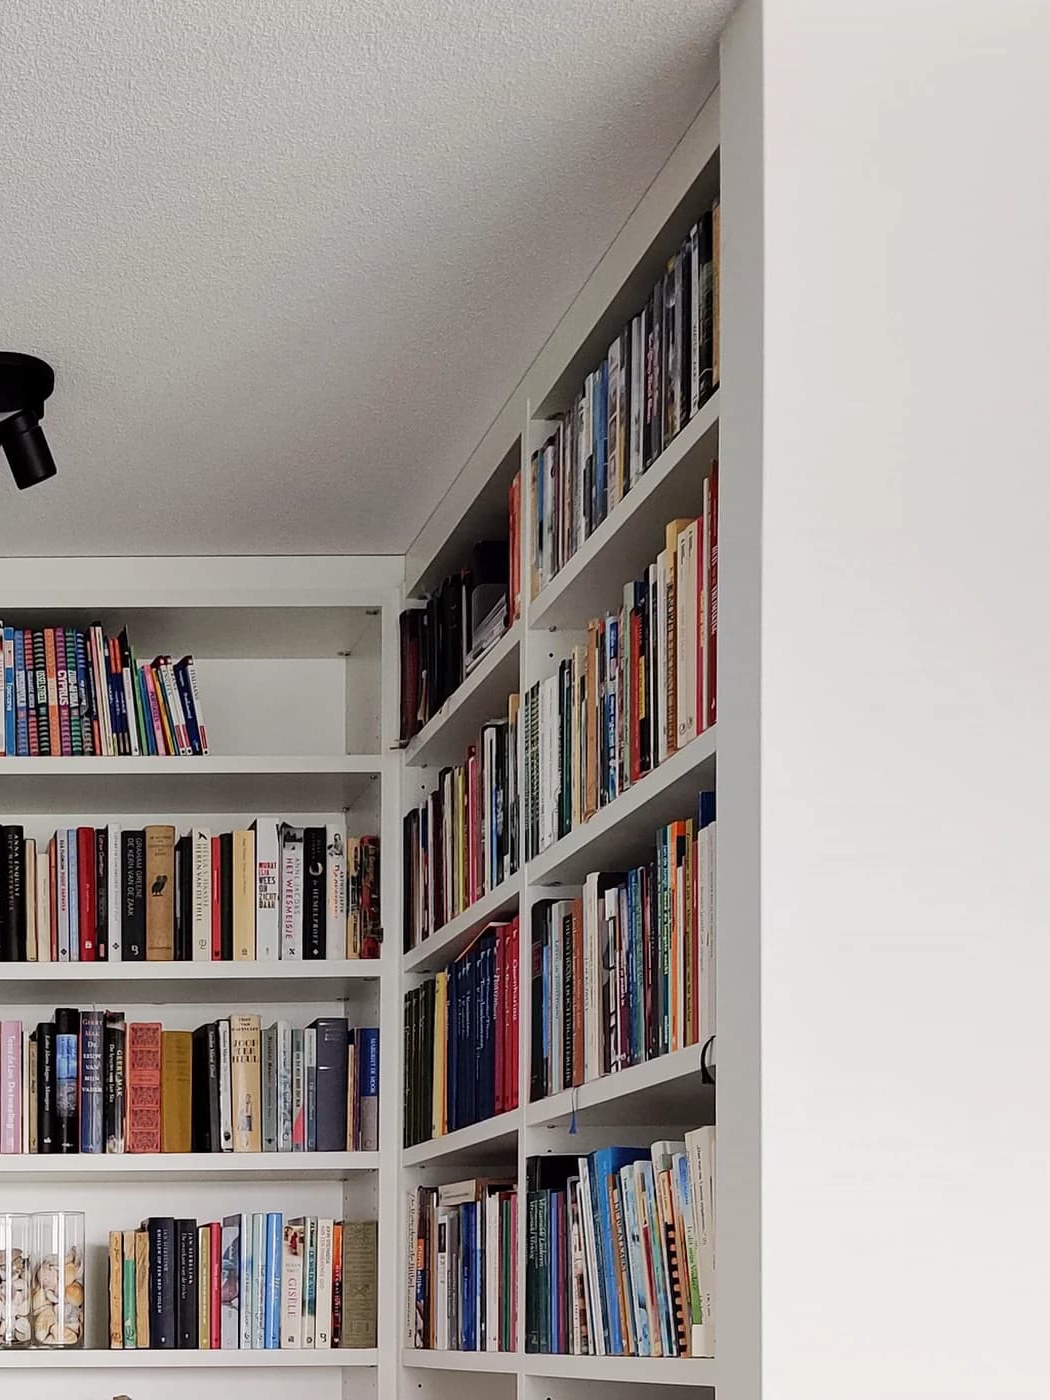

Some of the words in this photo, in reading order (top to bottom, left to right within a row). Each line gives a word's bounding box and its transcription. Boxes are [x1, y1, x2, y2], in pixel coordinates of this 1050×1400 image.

[58, 670, 69, 706] CYPRUS
[126, 838, 134, 848] DE
[126, 850, 134, 870] KERN
[126, 870, 134, 885] VAN
[258, 876, 276, 884] WEES
[126, 886, 134, 897] DE
[126, 898, 134, 916] ZAAK
[285, 880, 293, 940] WEESMEISJE
[6, 1094, 16, 1129] tweeling
